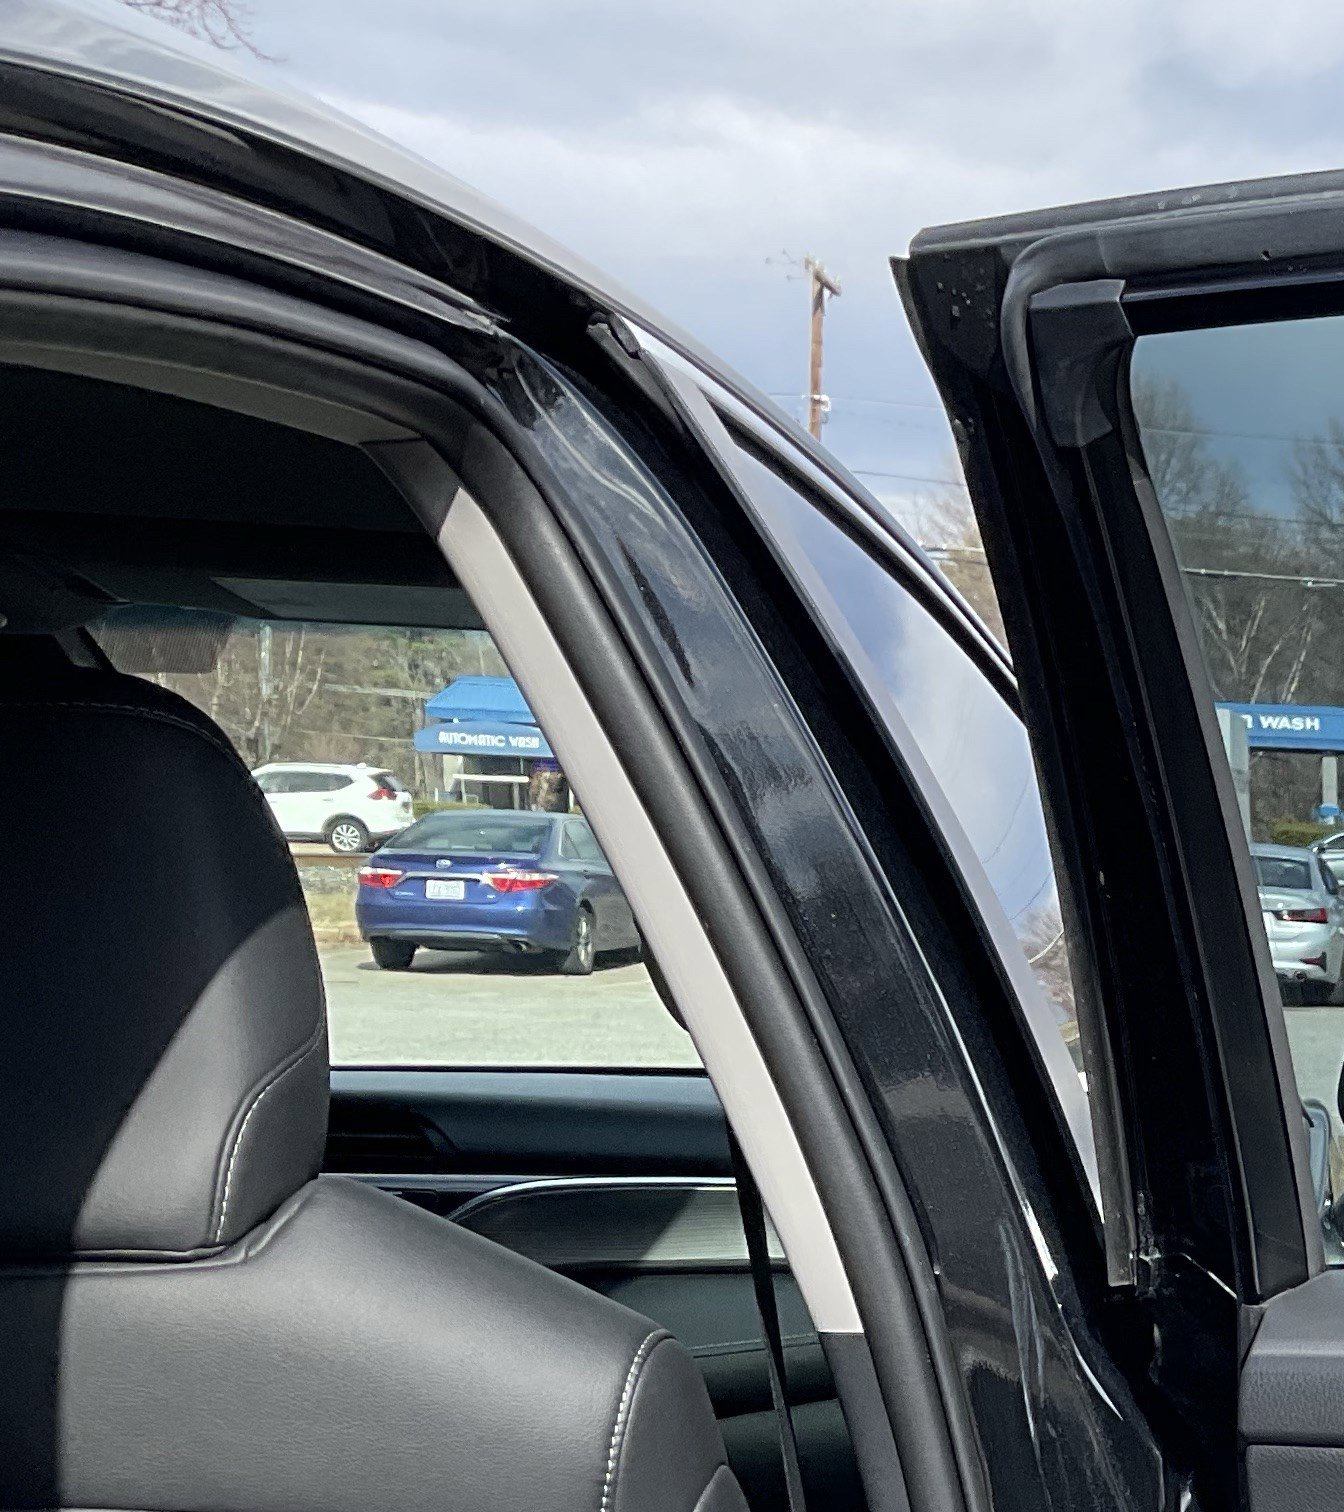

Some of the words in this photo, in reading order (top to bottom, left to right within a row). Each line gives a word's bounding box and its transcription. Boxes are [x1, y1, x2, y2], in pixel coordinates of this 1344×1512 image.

[1260, 714, 1320, 731] WASH
[438, 731, 506, 748] AUTOMATIC
[509, 736, 540, 749] WASH
